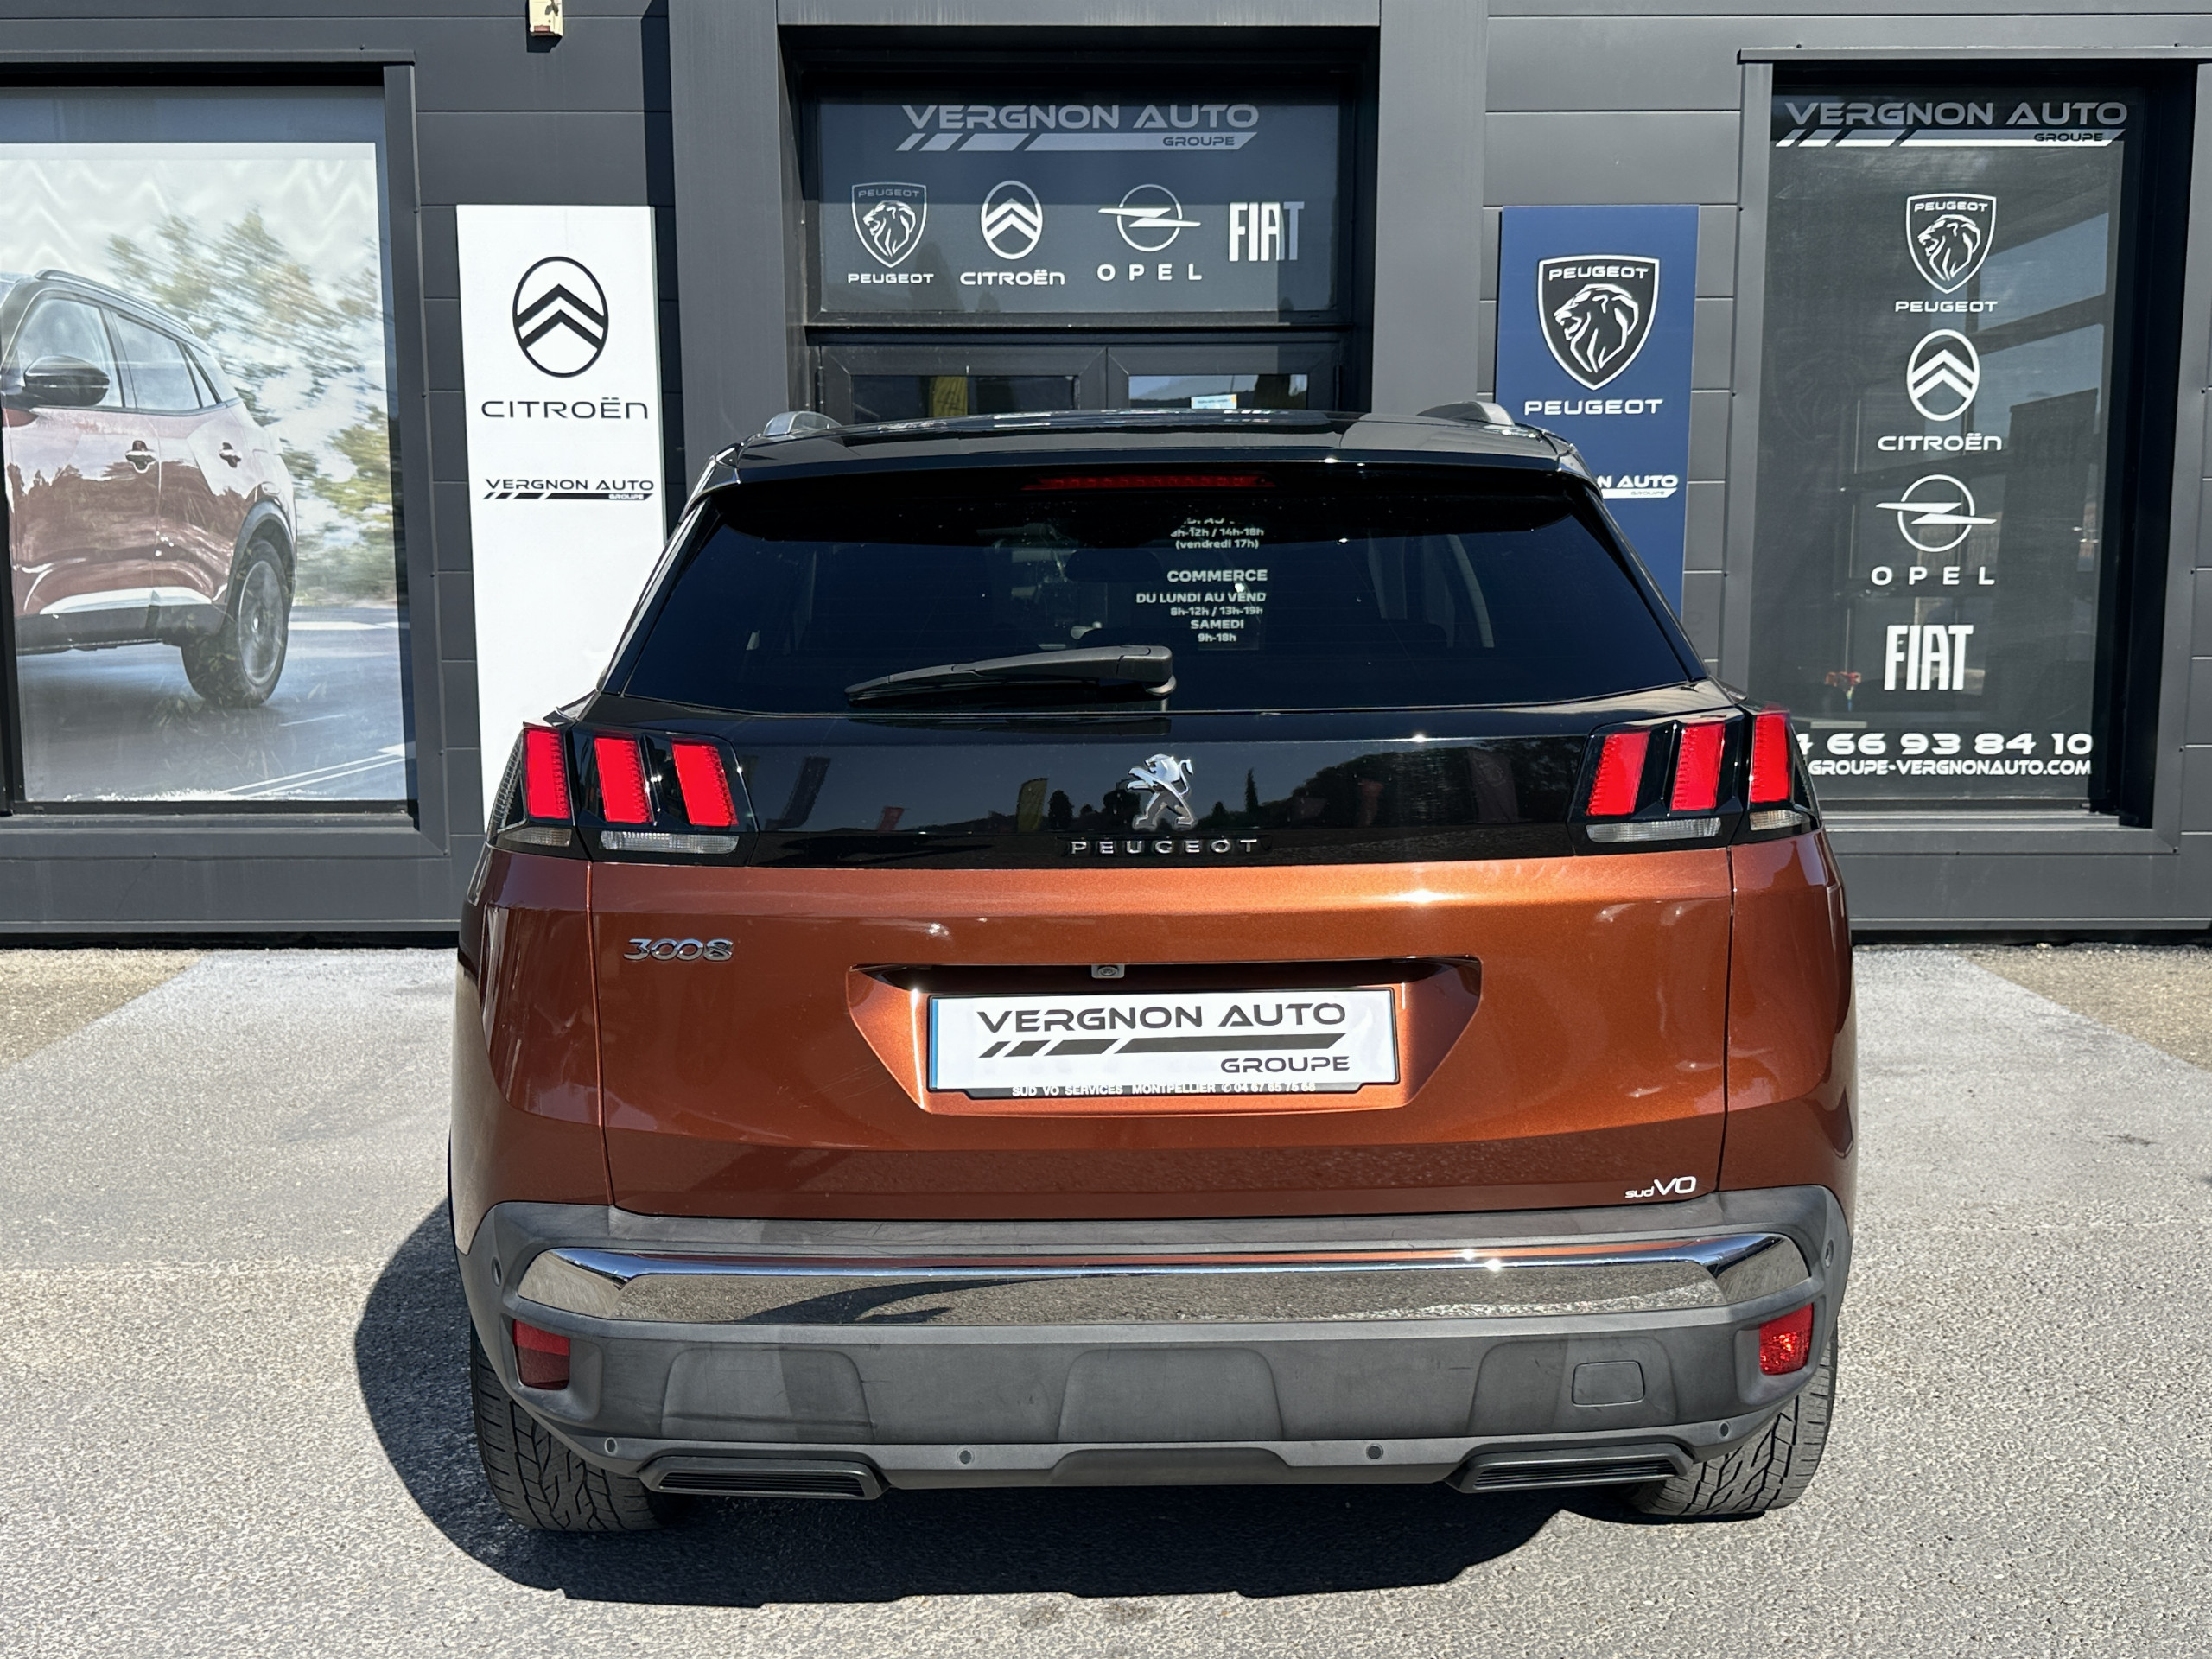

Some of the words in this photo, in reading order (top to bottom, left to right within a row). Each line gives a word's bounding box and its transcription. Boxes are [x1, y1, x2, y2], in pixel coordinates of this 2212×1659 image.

[901, 105, 1119, 129] VERGNON
[1133, 104, 1259, 128] AUTO
[1785, 102, 1993, 124] VERGNON
[2005, 102, 2127, 124] AUTO
[1162, 136, 1235, 147] GROUPE
[2033, 132, 2104, 142] GROUPE
[858, 188, 920, 198] PEUGEOT
[1914, 201, 1988, 212] PEUGEOT
[1229, 201, 1305, 261] FIAT
[848, 273, 934, 284] PEUGEOT
[960, 270, 1065, 286] CITROËN
[1097, 263, 1202, 281] OPEL
[1548, 266, 1649, 281] PEUGEOT
[1895, 302, 1998, 313] PEUGEOT
[481, 397, 648, 419] CITROËN
[1524, 399, 1663, 416] PEUGEOT
[1878, 433, 2002, 451] CITROËN
[486, 479, 588, 490] VERGNON
[595, 480, 654, 491] AUTO
[1616, 474, 1679, 488] AUTO
[1167, 569, 1268, 582] COMMERCE
[1871, 566, 1995, 585] OPEL
[1136, 593, 1156, 603] DU
[1160, 593, 1201, 603] LUNDI
[1205, 592, 1224, 602] AU
[1191, 620, 1244, 629] SAMEDI
[1198, 632, 1236, 642] 9h-18h
[1884, 625, 1974, 690] FIAT
[1827, 733, 1886, 755] 66
[1900, 733, 1961, 755] 93
[1974, 733, 2037, 755] 84
[2051, 733, 2094, 755] 10
[1071, 838, 1257, 855] PEUGEOT
[623, 938, 733, 961] 3008
[977, 1006, 1202, 1033] VERGNON
[1217, 1002, 1346, 1027] AUTO
[1220, 1056, 1350, 1073] GROUPE
[1012, 1086, 1037, 1096] SUD
[1042, 1086, 1059, 1096] VO
[1065, 1085, 1123, 1095] SERVICES
[1132, 1084, 1216, 1094] MONTPELLIER
[1234, 1083, 1248, 1092] 04
